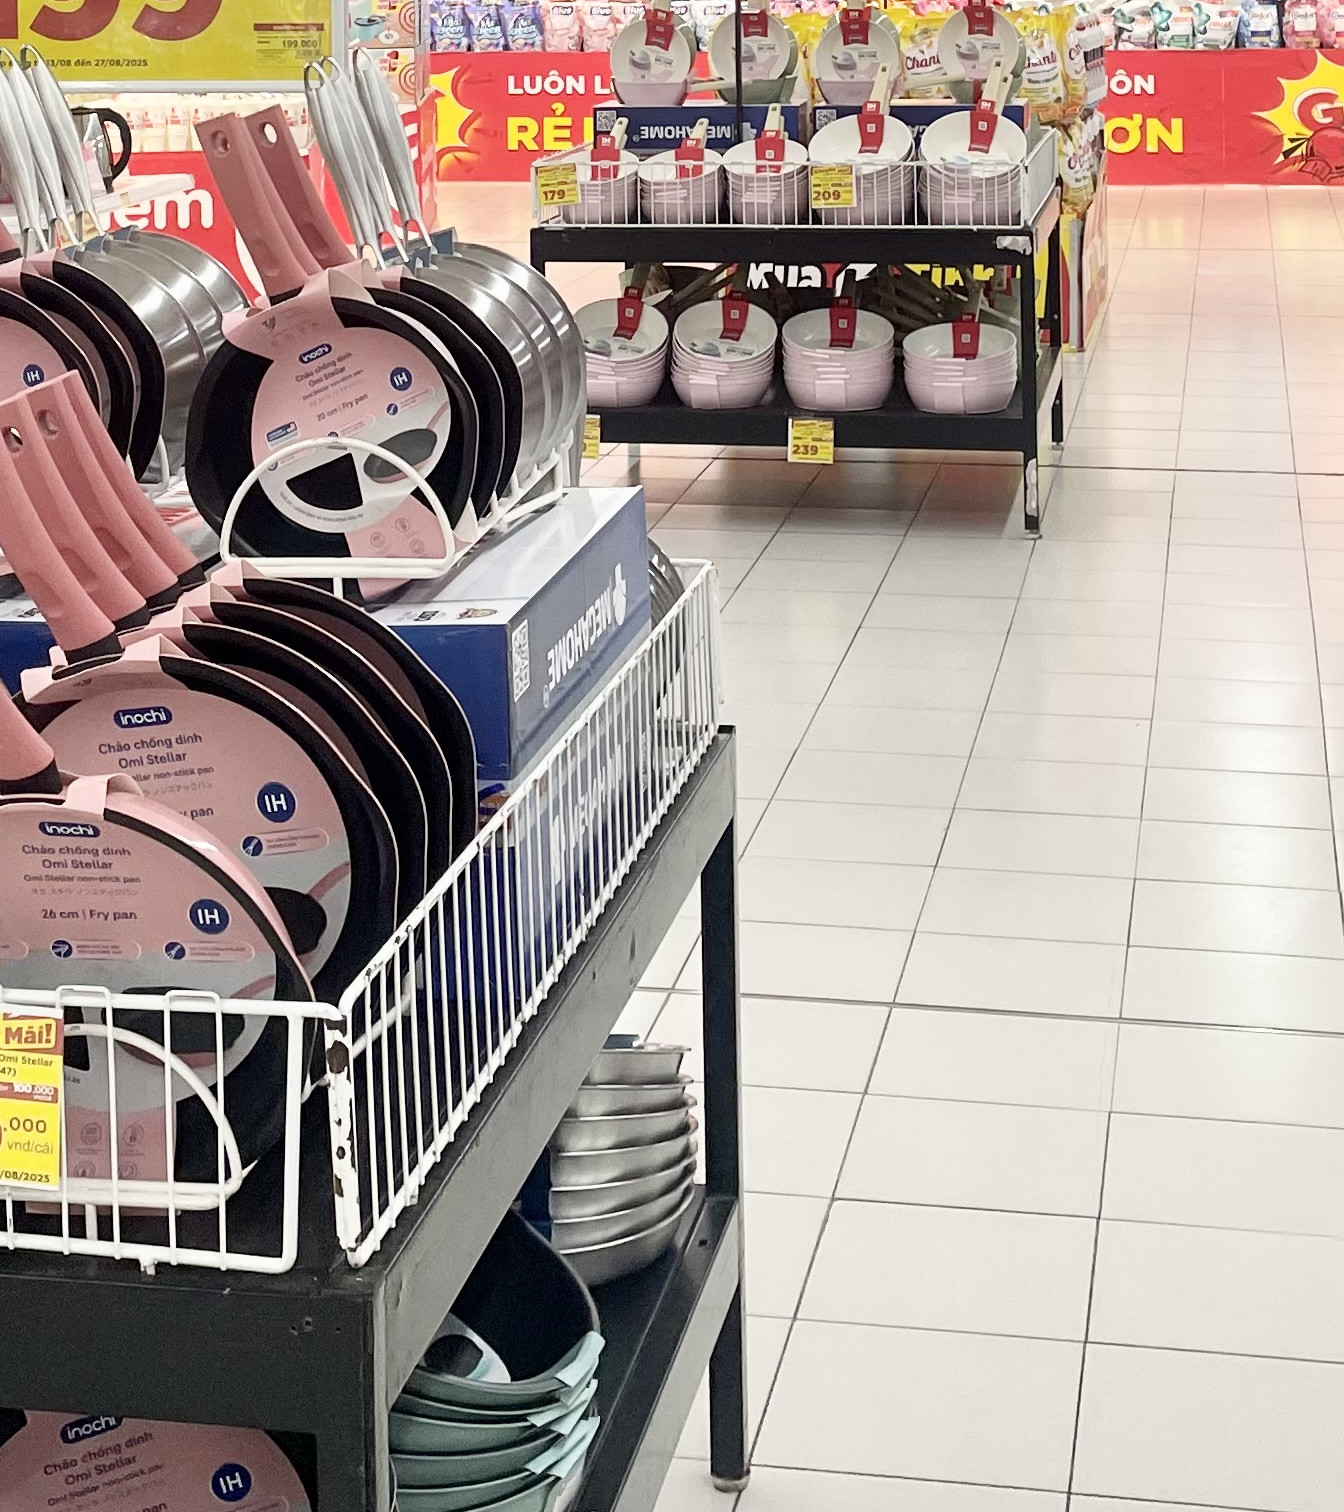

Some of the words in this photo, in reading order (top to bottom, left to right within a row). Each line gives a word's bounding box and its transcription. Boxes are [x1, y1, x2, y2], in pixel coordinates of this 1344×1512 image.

[507, 70, 586, 96] LUÔN
[507, 102, 573, 152] RẺ
[542, 189, 566, 202] 179
[812, 189, 842, 202] 209
[792, 444, 819, 457] 239
[119, 707, 168, 726] inochi
[98, 740, 131, 755] Chảo
[133, 734, 173, 750] chống
[118, 756, 144, 769] Omi
[146, 751, 188, 766] Stellar
[45, 822, 95, 837] inochi
[57, 844, 100, 859] chống
[41, 858, 69, 871] Omi
[71, 857, 114, 870] Stellar
[41, 907, 57, 920] 26
[59, 908, 80, 920] cm
[88, 908, 110, 923] Fry
[112, 908, 138, 922] pan
[4, 1023, 53, 1045] Mãi!
[21, 1056, 54, 1068] Stellar
[6, 1138, 54, 1156] vnd/cái
